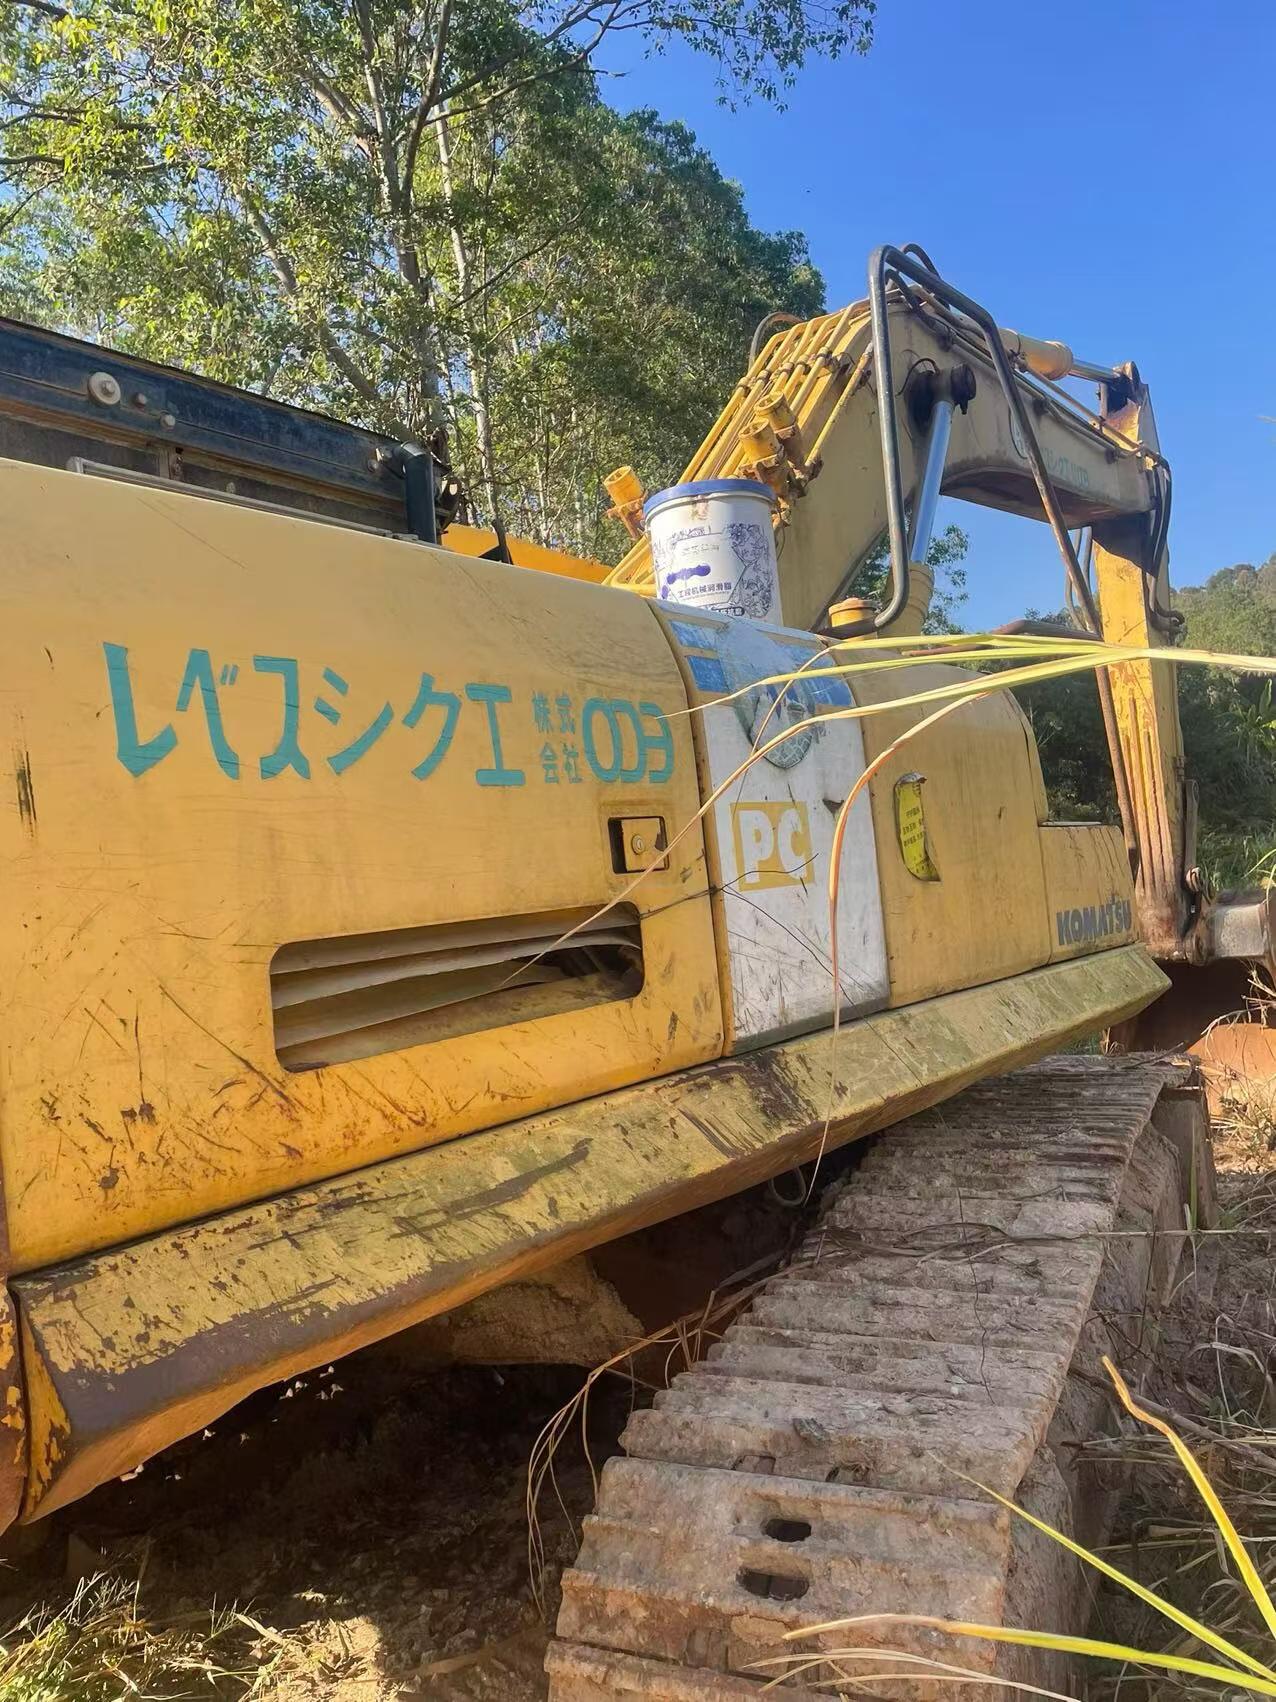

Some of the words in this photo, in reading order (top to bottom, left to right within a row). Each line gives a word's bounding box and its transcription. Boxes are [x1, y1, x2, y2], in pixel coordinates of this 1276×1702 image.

[540, 741, 582, 784] 会社
[739, 808, 807, 884] PC
[1056, 899, 1132, 945] KOMATSU
